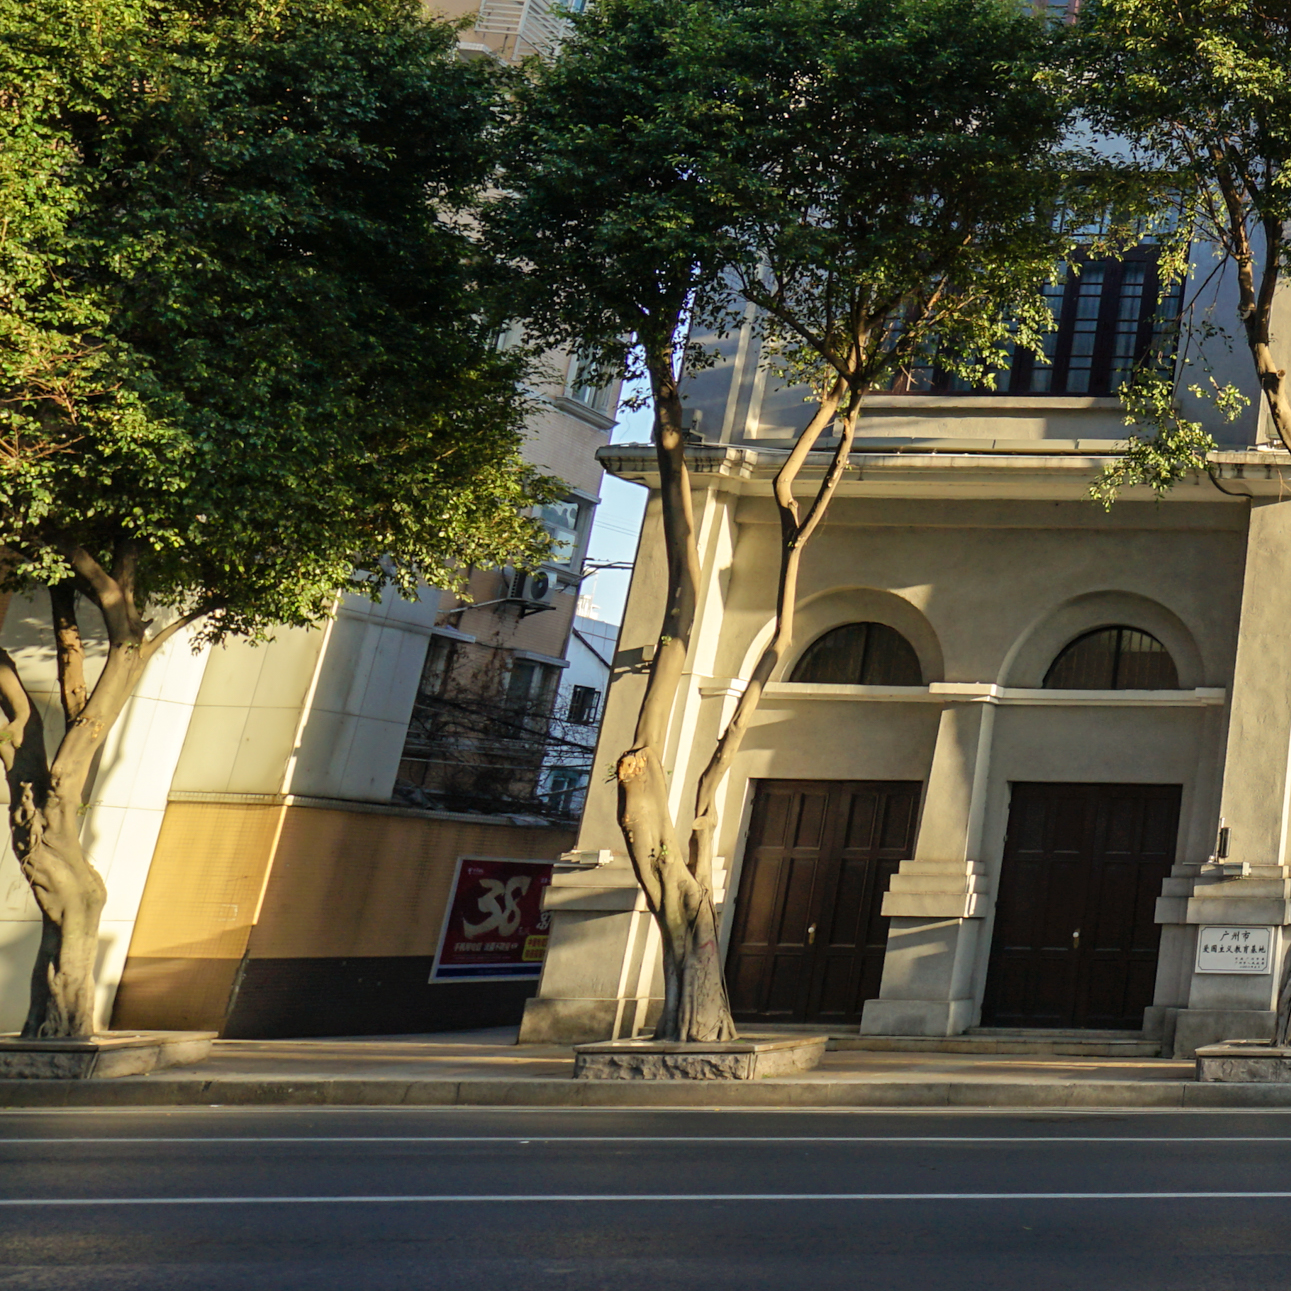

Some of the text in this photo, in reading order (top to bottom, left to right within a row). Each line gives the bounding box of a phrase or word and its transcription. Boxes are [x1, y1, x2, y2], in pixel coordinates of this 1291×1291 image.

[1219, 930, 1251, 942] 广州市
[1202, 944, 1267, 954] 爱国主义教育基地
